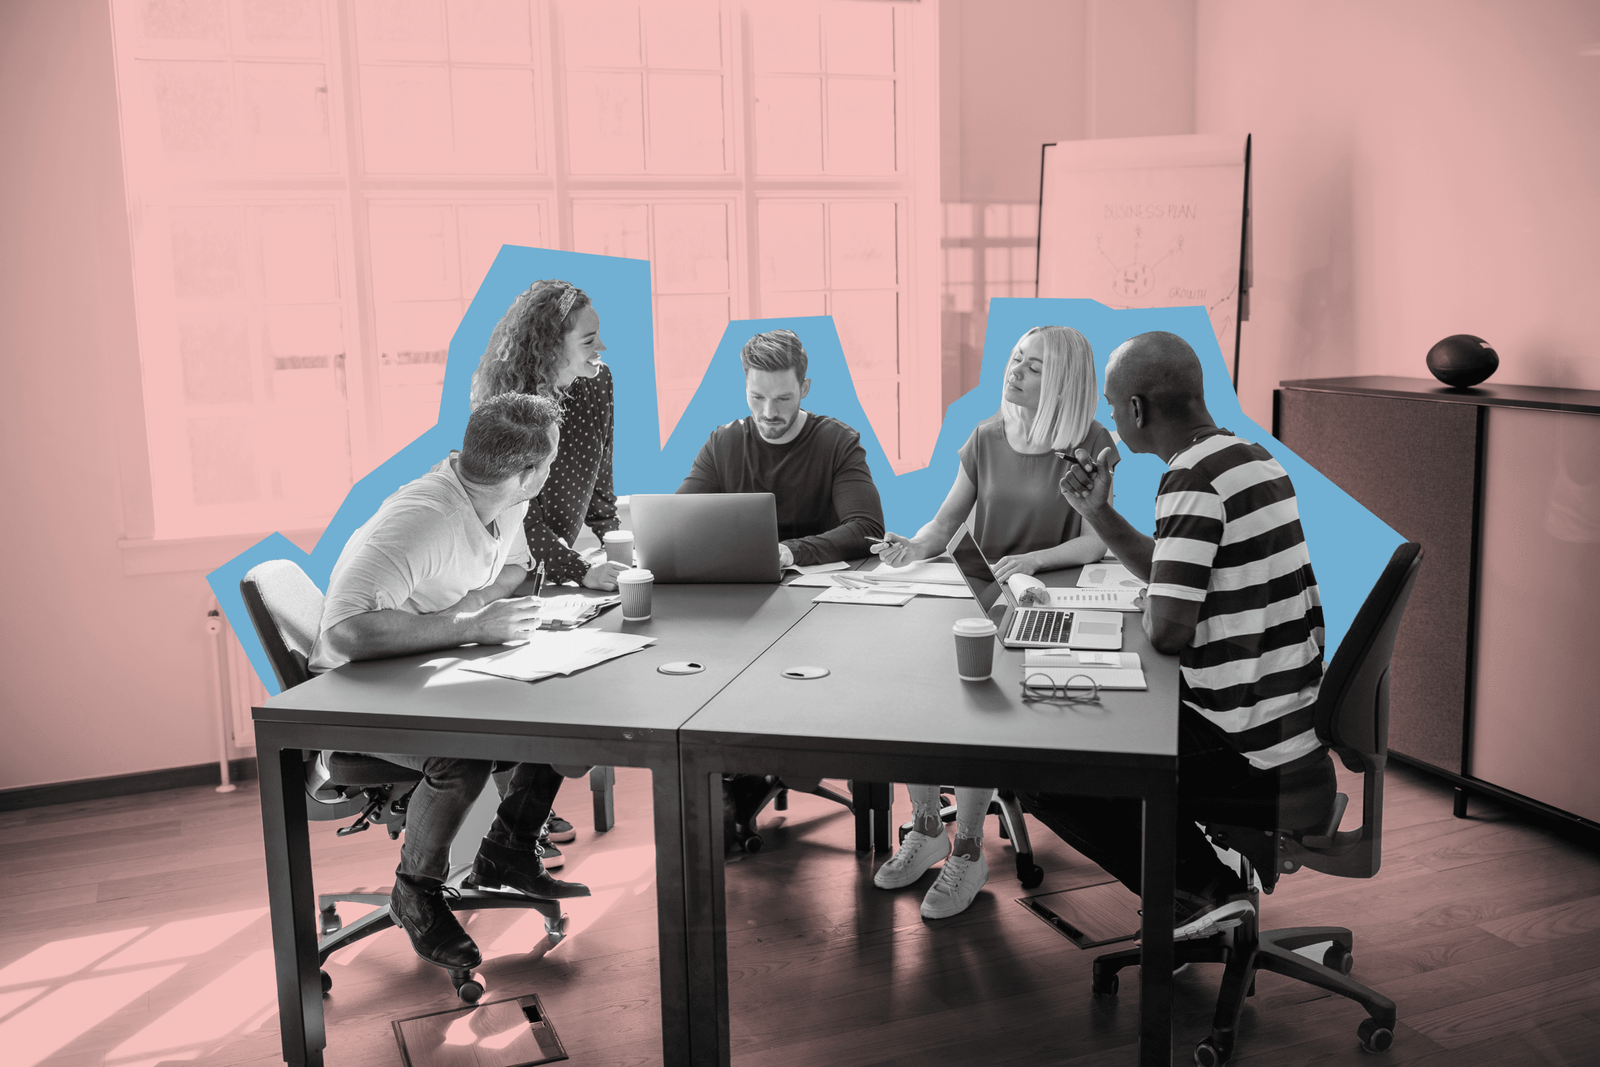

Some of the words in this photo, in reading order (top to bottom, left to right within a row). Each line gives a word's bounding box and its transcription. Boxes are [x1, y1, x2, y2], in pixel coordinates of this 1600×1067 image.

[1104, 204, 1165, 220] BUSINESS
[1167, 204, 1197, 219] PLAN
[1168, 287, 1207, 300] GROWTH
